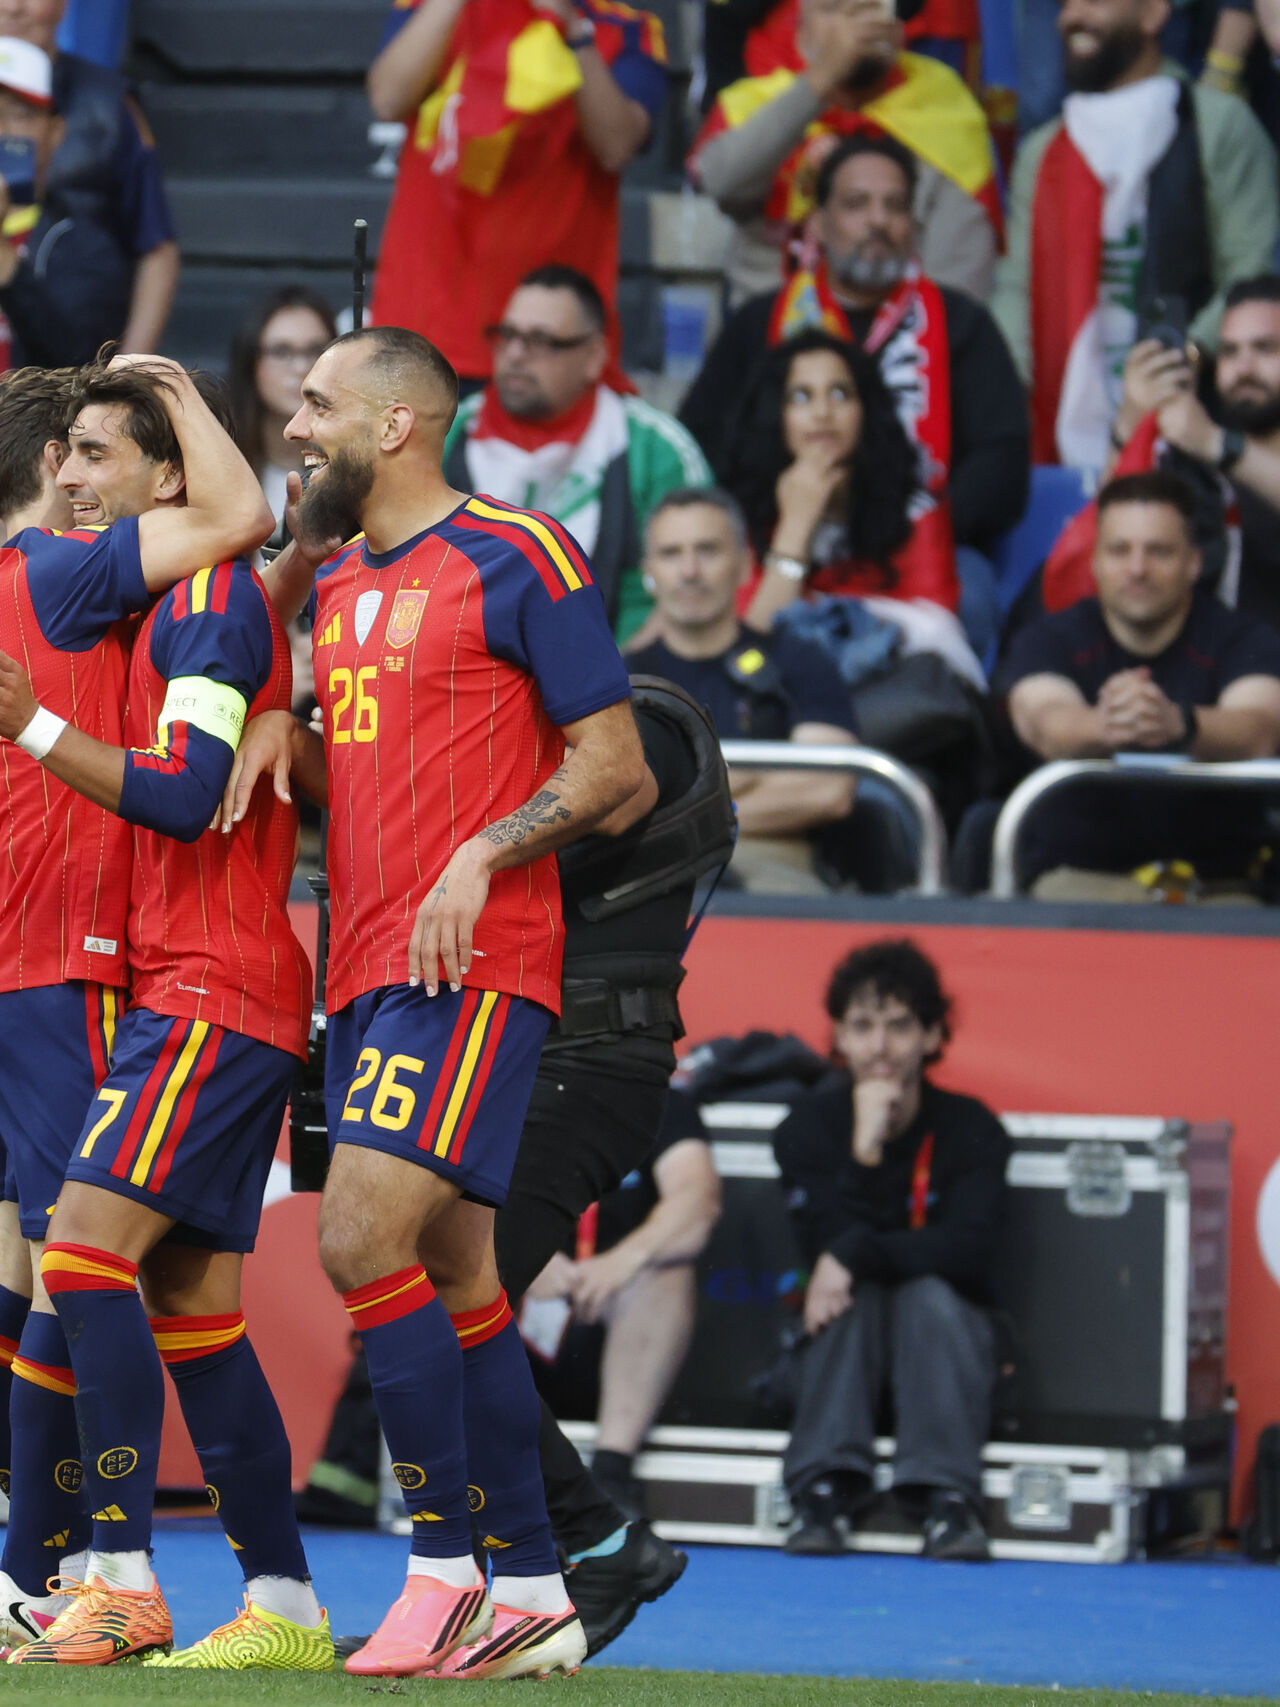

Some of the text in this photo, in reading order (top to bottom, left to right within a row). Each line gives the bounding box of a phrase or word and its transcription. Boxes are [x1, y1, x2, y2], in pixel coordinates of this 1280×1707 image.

[329, 666, 378, 744] 26
[342, 1047, 425, 1131] 26
[79, 1089, 128, 1159] 7
[107, 1453, 129, 1464] RF
[63, 1465, 82, 1477] RF
[107, 1462, 128, 1474] EF
[62, 1475, 80, 1486] EF
